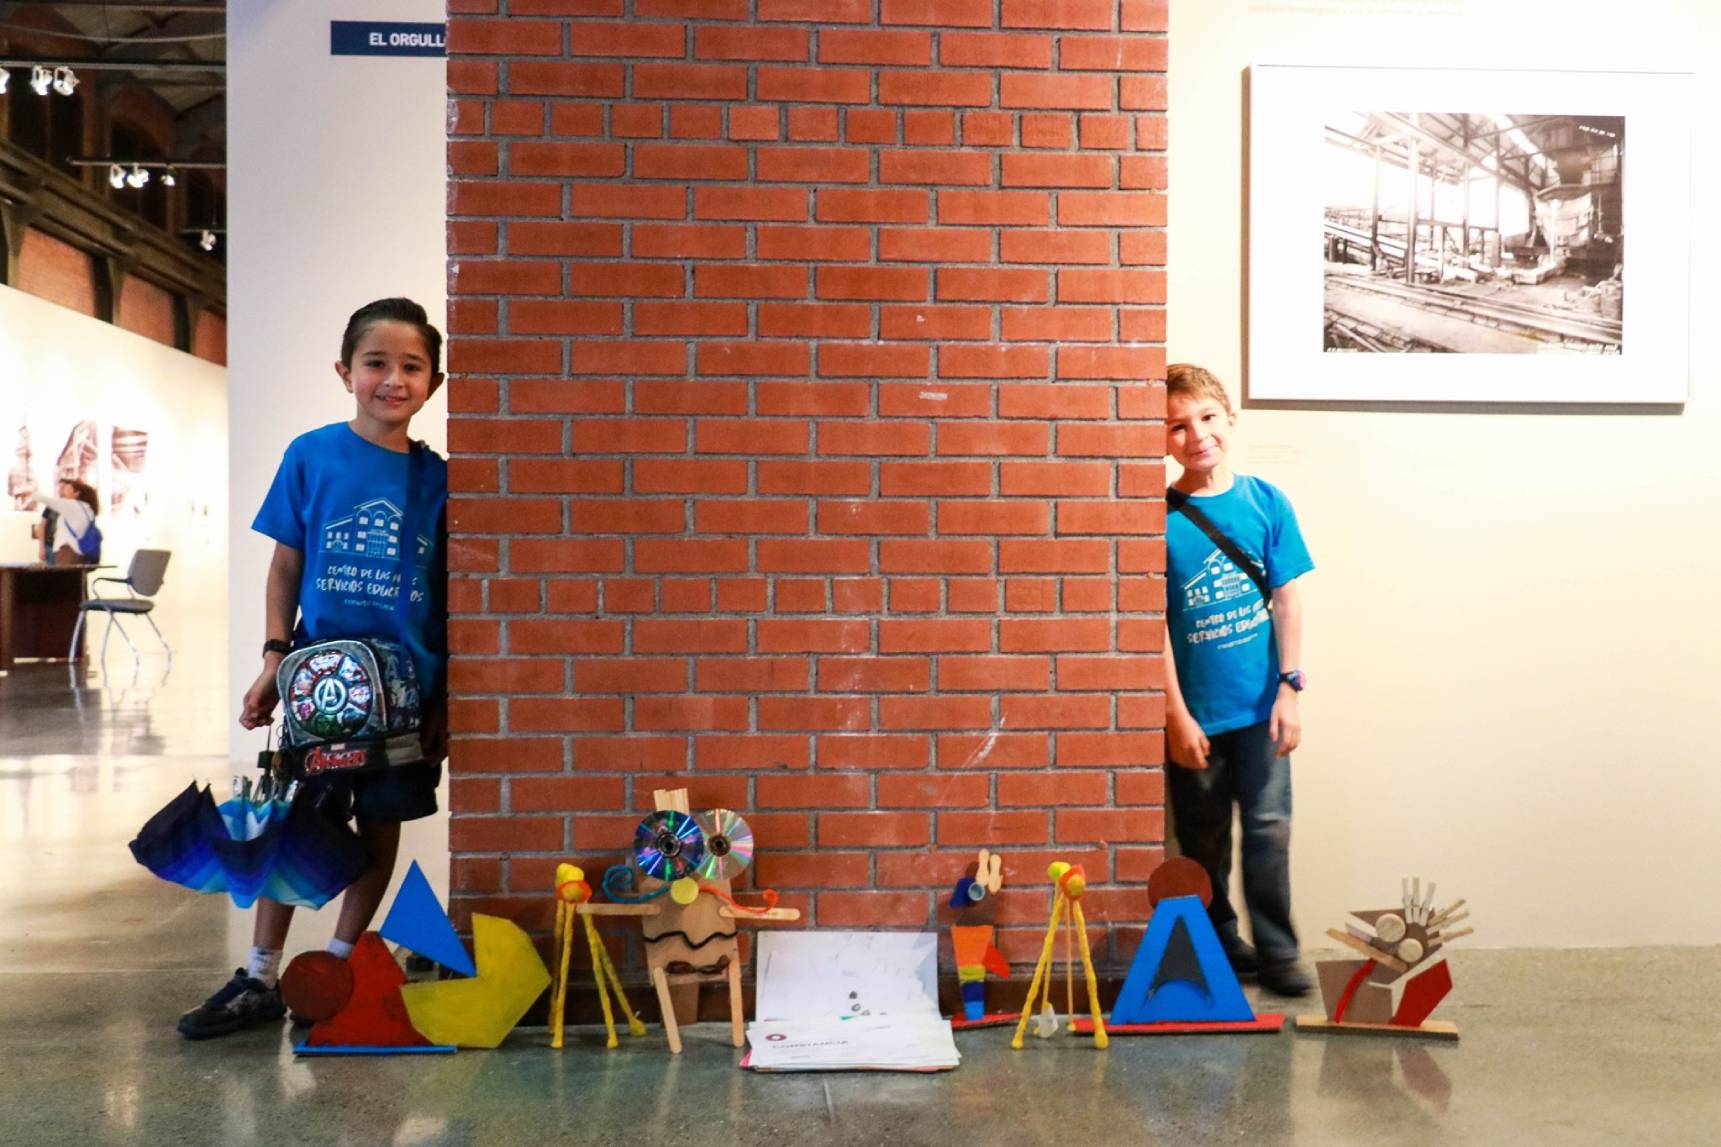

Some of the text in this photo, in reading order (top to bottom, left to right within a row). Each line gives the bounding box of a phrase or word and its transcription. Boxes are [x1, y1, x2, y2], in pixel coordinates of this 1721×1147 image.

[369, 32, 446, 47] EL ORGULL
[360, 568, 373, 579] DE
[315, 578, 364, 593] SERVICIOS
